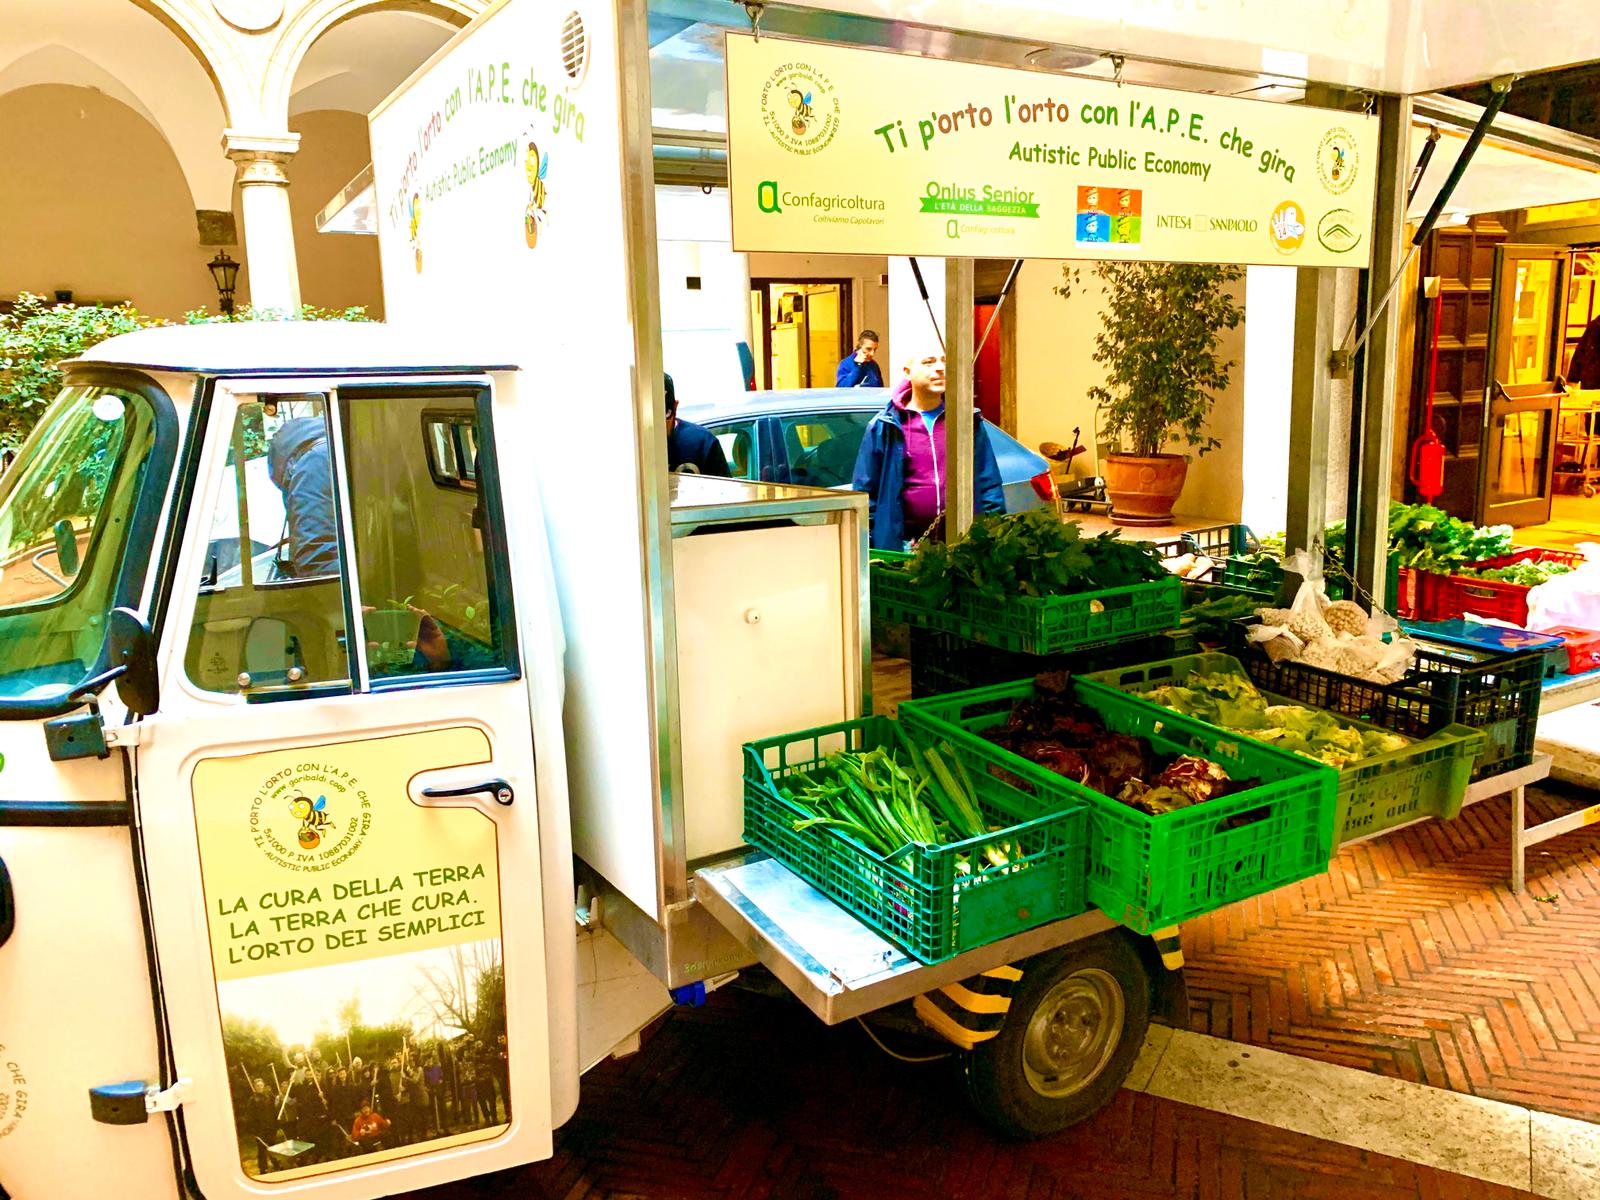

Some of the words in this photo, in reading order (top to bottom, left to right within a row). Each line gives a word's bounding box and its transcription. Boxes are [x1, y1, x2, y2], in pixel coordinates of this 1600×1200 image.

[418, 111, 442, 158] l'orto
[444, 86, 462, 122] con
[467, 61, 515, 105] l'A.P.E.
[522, 67, 547, 112] che
[552, 86, 586, 143] gira
[874, 120, 908, 154] Ti
[918, 102, 993, 151] p'orto
[1004, 95, 1069, 124] l'orto
[1080, 102, 1119, 127] con
[1129, 100, 1208, 144] l'A.P.E.
[1219, 127, 1254, 158] che
[1258, 147, 1296, 184] gira
[453, 155, 476, 188] Public
[478, 138, 518, 176] Economy
[1008, 141, 1081, 166] Autistic
[1087, 146, 1137, 172] Public
[1144, 151, 1212, 183] Economy
[782, 191, 885, 212] Confagricoltura
[926, 181, 976, 201] Onlus
[982, 184, 1035, 204] Senior
[959, 203, 984, 212] DELLA
[1156, 214, 1192, 229] INTESA
[1209, 217, 1258, 232] SANPAOLO
[296, 763, 320, 773] CON
[357, 790, 371, 809] CHE
[218, 897, 248, 916] LA
[259, 887, 322, 910] CURA
[333, 876, 404, 901] DELLA
[413, 863, 485, 888] TERRA
[303, 863, 331, 873] PUBLIC
[230, 920, 260, 939] LA
[270, 908, 347, 934] TERRA
[357, 898, 401, 921] CHE
[411, 889, 478, 912] CURA.
[228, 937, 314, 964] L'ORTO
[326, 929, 368, 950] DEI
[378, 910, 486, 943] SEMPLICI
[6, 1061, 26, 1085] CHE
